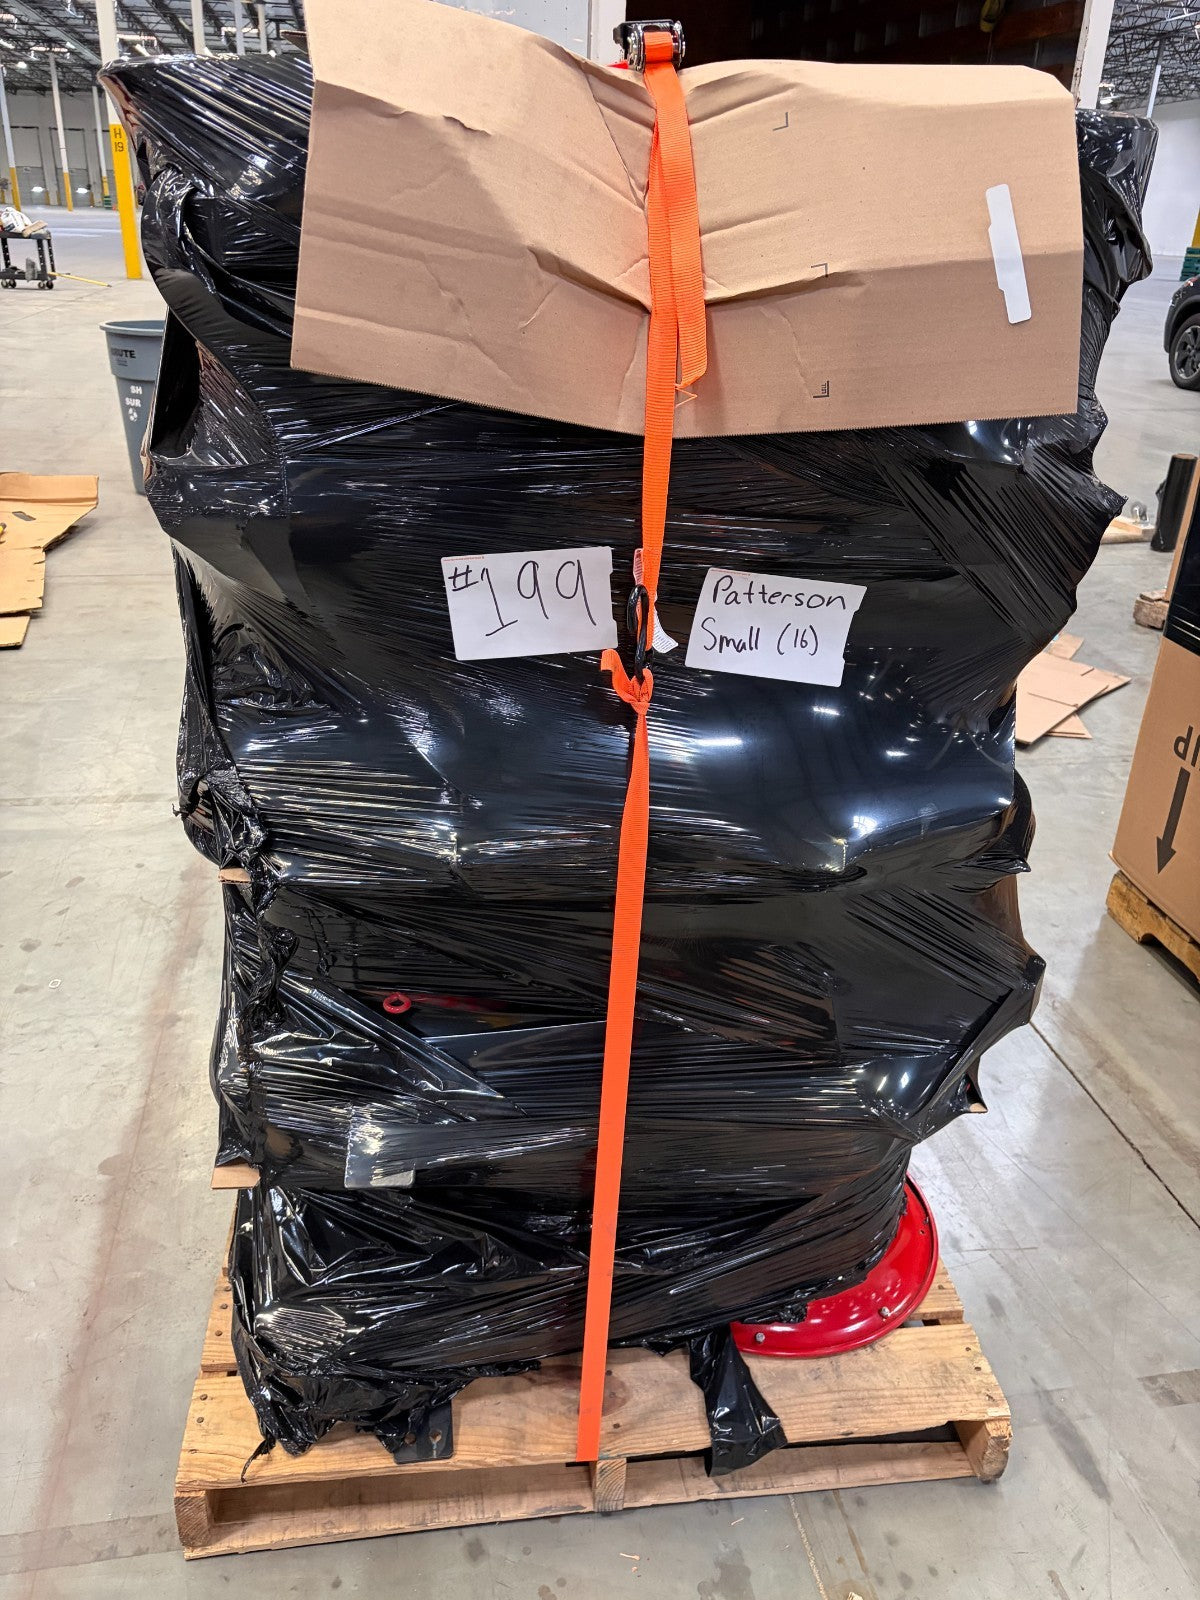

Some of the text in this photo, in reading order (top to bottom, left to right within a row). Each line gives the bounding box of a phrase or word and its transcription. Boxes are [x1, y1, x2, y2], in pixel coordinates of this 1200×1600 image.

[113, 127, 122, 139] H
[114, 141, 124, 152] 19
[447, 559, 597, 637] #199
[712, 574, 846, 610] Patterson
[700, 616, 761, 654] Small
[776, 622, 819, 656] (16)
